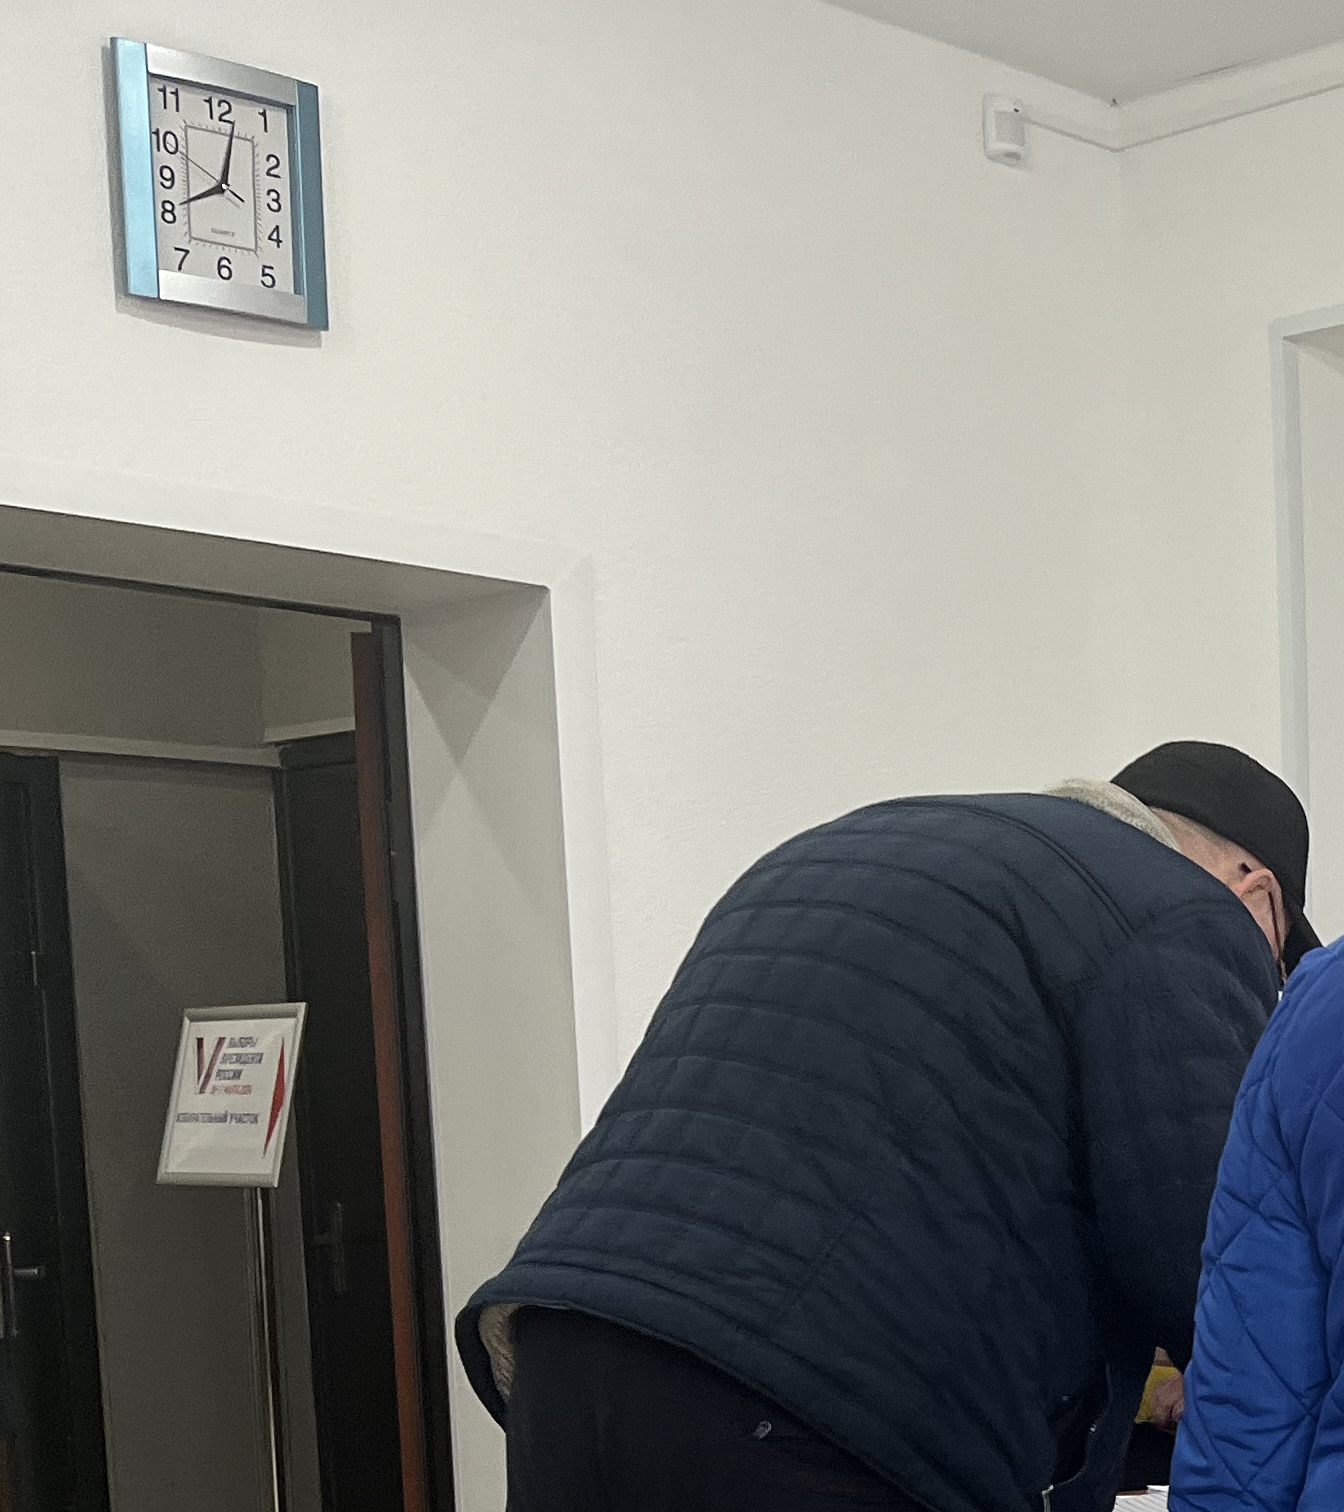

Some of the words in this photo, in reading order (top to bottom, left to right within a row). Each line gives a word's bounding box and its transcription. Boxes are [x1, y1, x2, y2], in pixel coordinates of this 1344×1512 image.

[158, 85, 180, 112] 11
[204, 96, 234, 124] 12
[258, 108, 269, 133] 1
[152, 127, 179, 155] 10
[159, 165, 175, 190] 9
[265, 154, 282, 179] 2
[161, 200, 177, 224] 8
[266, 188, 282, 213] 3
[268, 225, 283, 248] 4
[173, 247, 190, 271] 7
[217, 256, 233, 281] 6
[260, 265, 276, 289] 5
